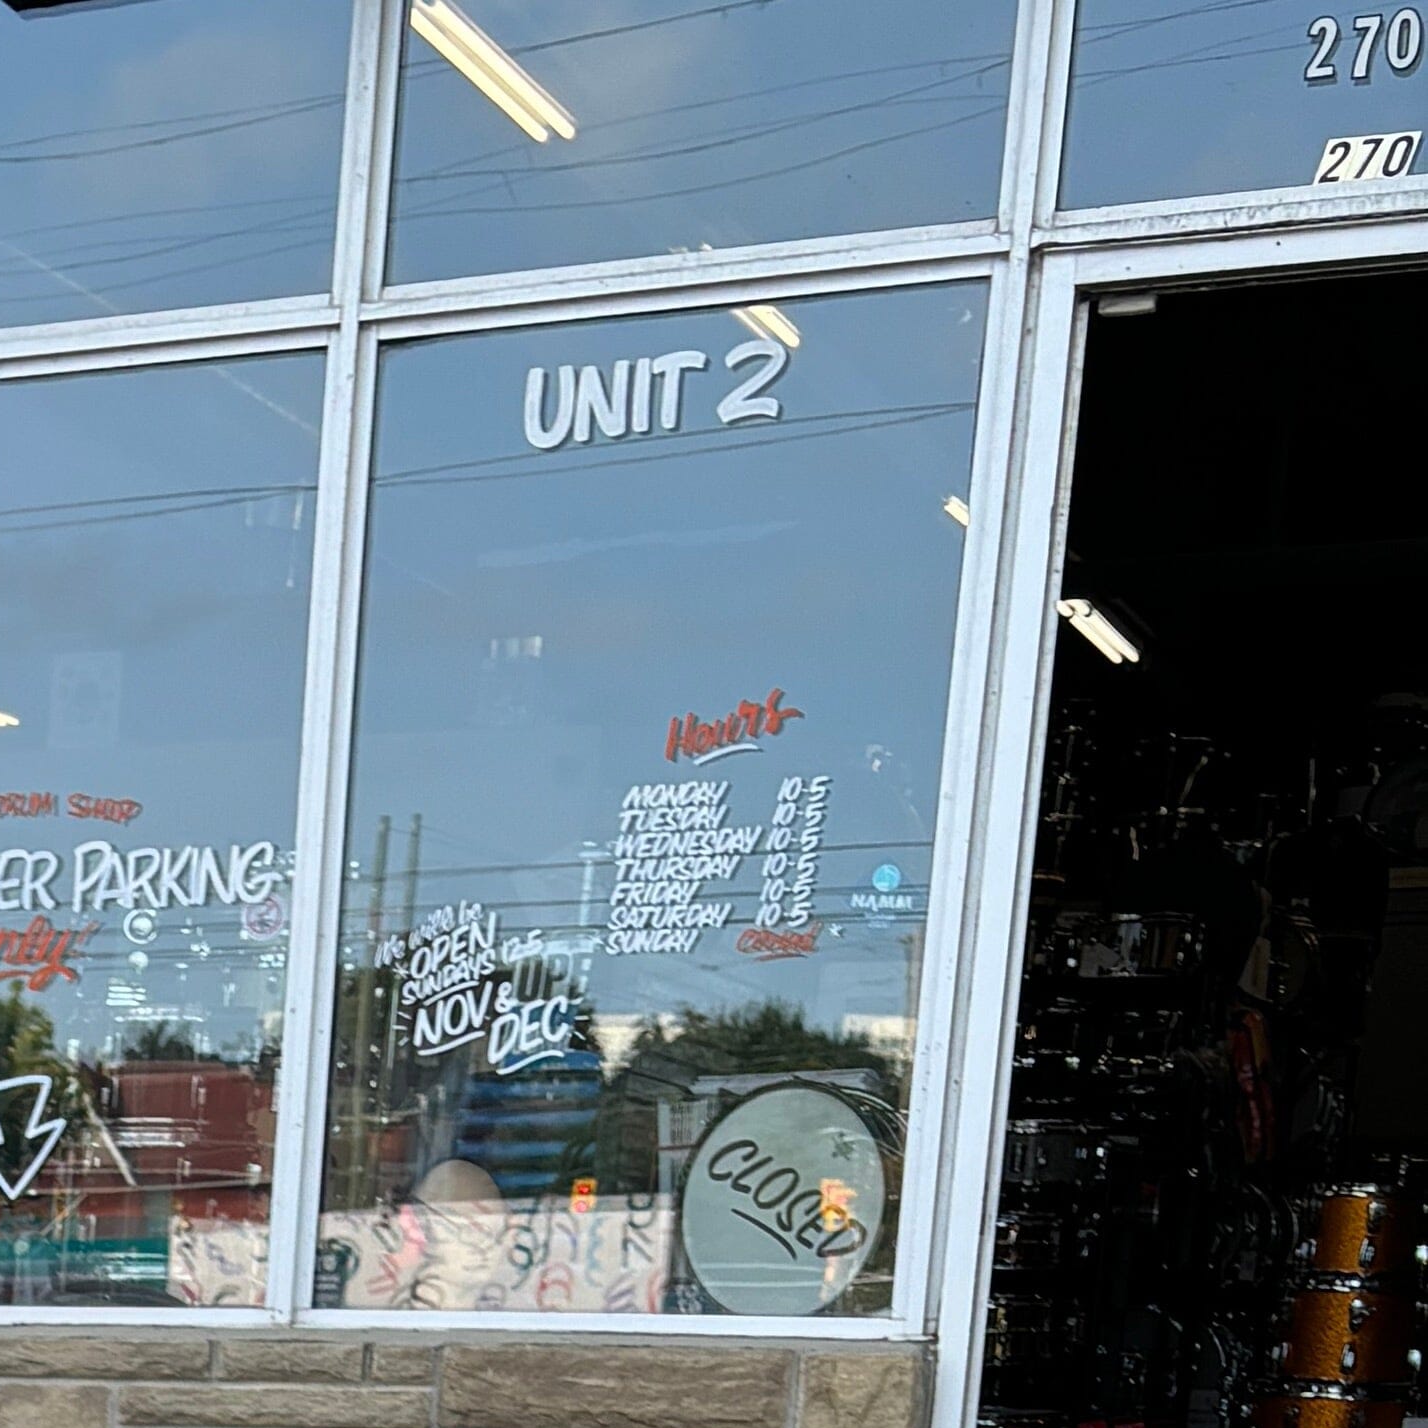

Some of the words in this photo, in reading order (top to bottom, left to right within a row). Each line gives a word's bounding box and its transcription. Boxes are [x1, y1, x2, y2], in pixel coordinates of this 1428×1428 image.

[1303, 7, 1423, 82] 270
[1318, 135, 1414, 184] 270
[525, 350, 707, 449] UNIT
[717, 340, 787, 424] 2
[665, 688, 805, 763] Hours
[68, 793, 141, 825] SHOP
[620, 805, 728, 831] TUESDAY
[773, 803, 826, 826] 10-5
[622, 781, 729, 809] MONDAY
[778, 776, 831, 801] 10-5
[614, 826, 762, 857] WEDNESDAY
[767, 828, 821, 852] 10-5
[72, 841, 282, 912] PARKING
[615, 855, 740, 880] THURSDAY
[763, 853, 817, 879] 10-5
[609, 903, 732, 930] SATURDAY
[756, 903, 811, 927] 10-5
[610, 881, 701, 906] FRIDAY
[760, 879, 812, 902] 10-5
[410, 912, 496, 979] OPEN
[605, 929, 699, 954] SUNDAY
[401, 948, 495, 1005] SUNDAYS
[494, 982, 516, 1013] &
[413, 981, 493, 1047] NOV
[488, 995, 569, 1064] DEC
[709, 1139, 867, 1258] CLOSED
